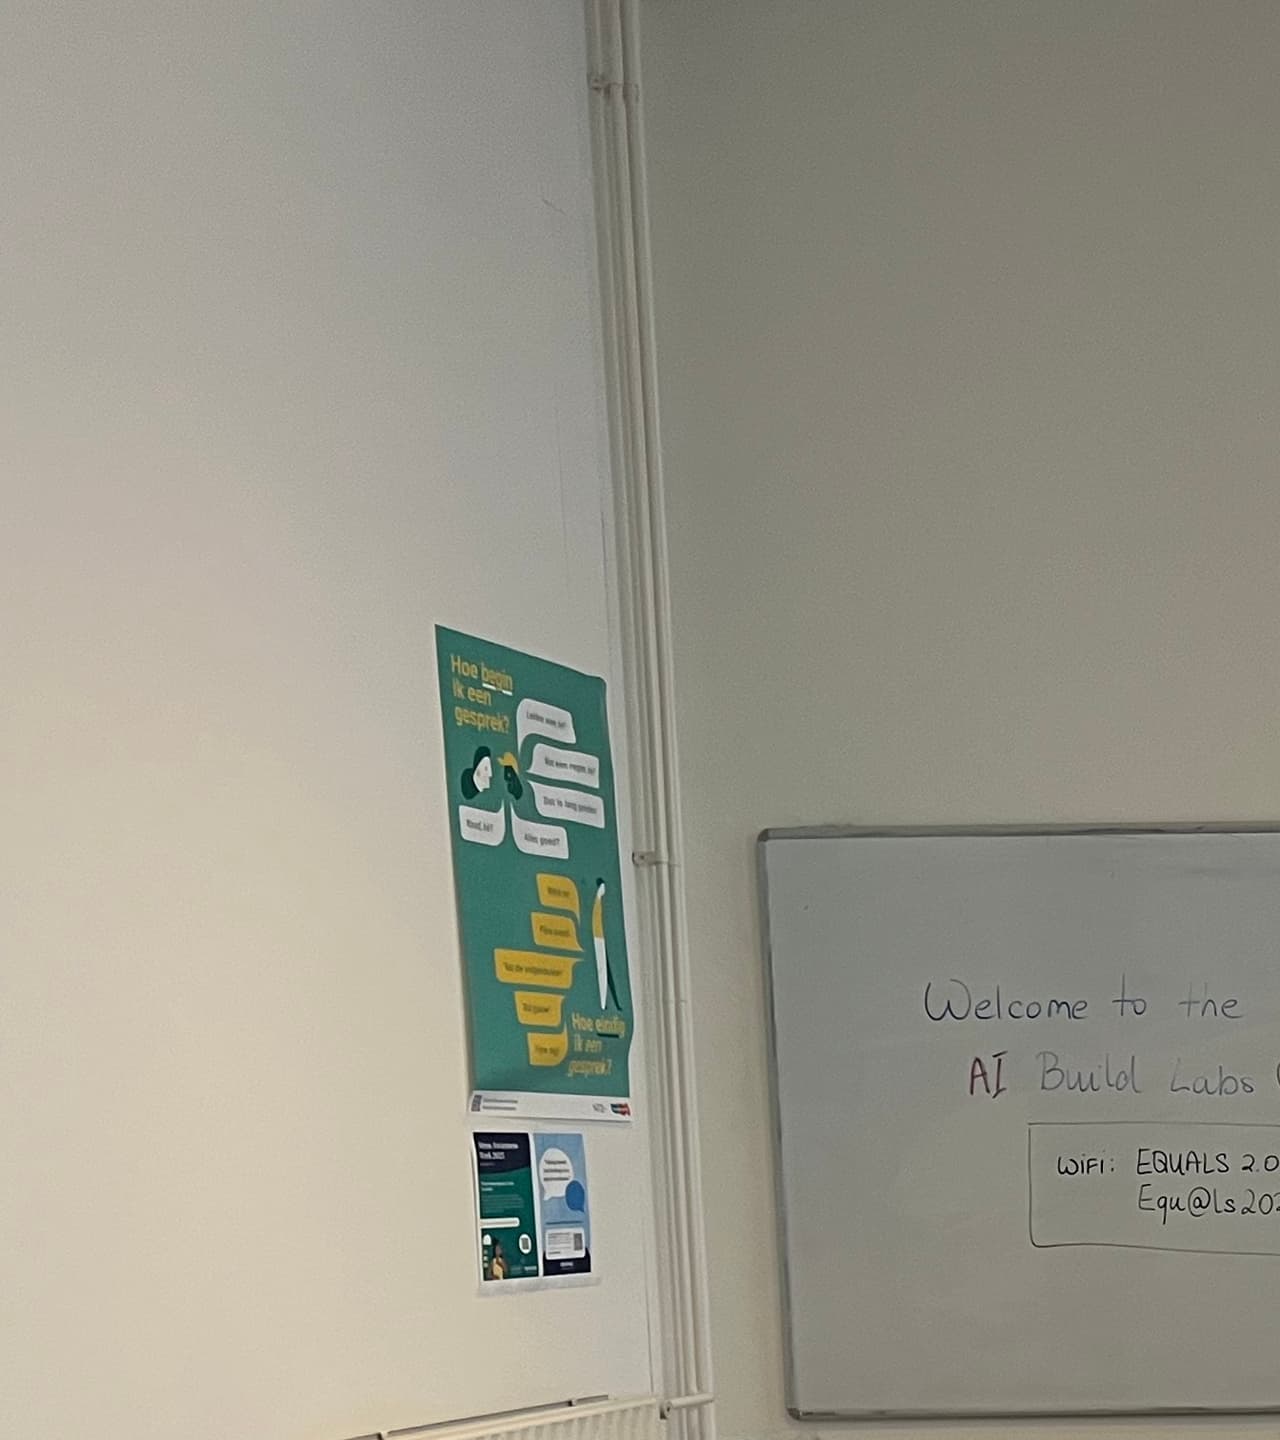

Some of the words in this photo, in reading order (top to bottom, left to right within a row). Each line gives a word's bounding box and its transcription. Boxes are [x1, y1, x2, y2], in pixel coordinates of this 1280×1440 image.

[451, 655, 478, 678] Hoe
[481, 663, 513, 691] begin
[467, 687, 492, 706] een
[454, 706, 509, 733] gesprek?
[924, 978, 1089, 1021] Welcome
[1111, 973, 1147, 1016] to
[1179, 982, 1244, 1020] the
[969, 1050, 1008, 1099] AI
[1035, 1051, 1141, 1095] Build
[1171, 1059, 1255, 1095] Labs
[1136, 1148, 1230, 1176] EQUALS
[1241, 1153, 1280, 1174] 2.0
